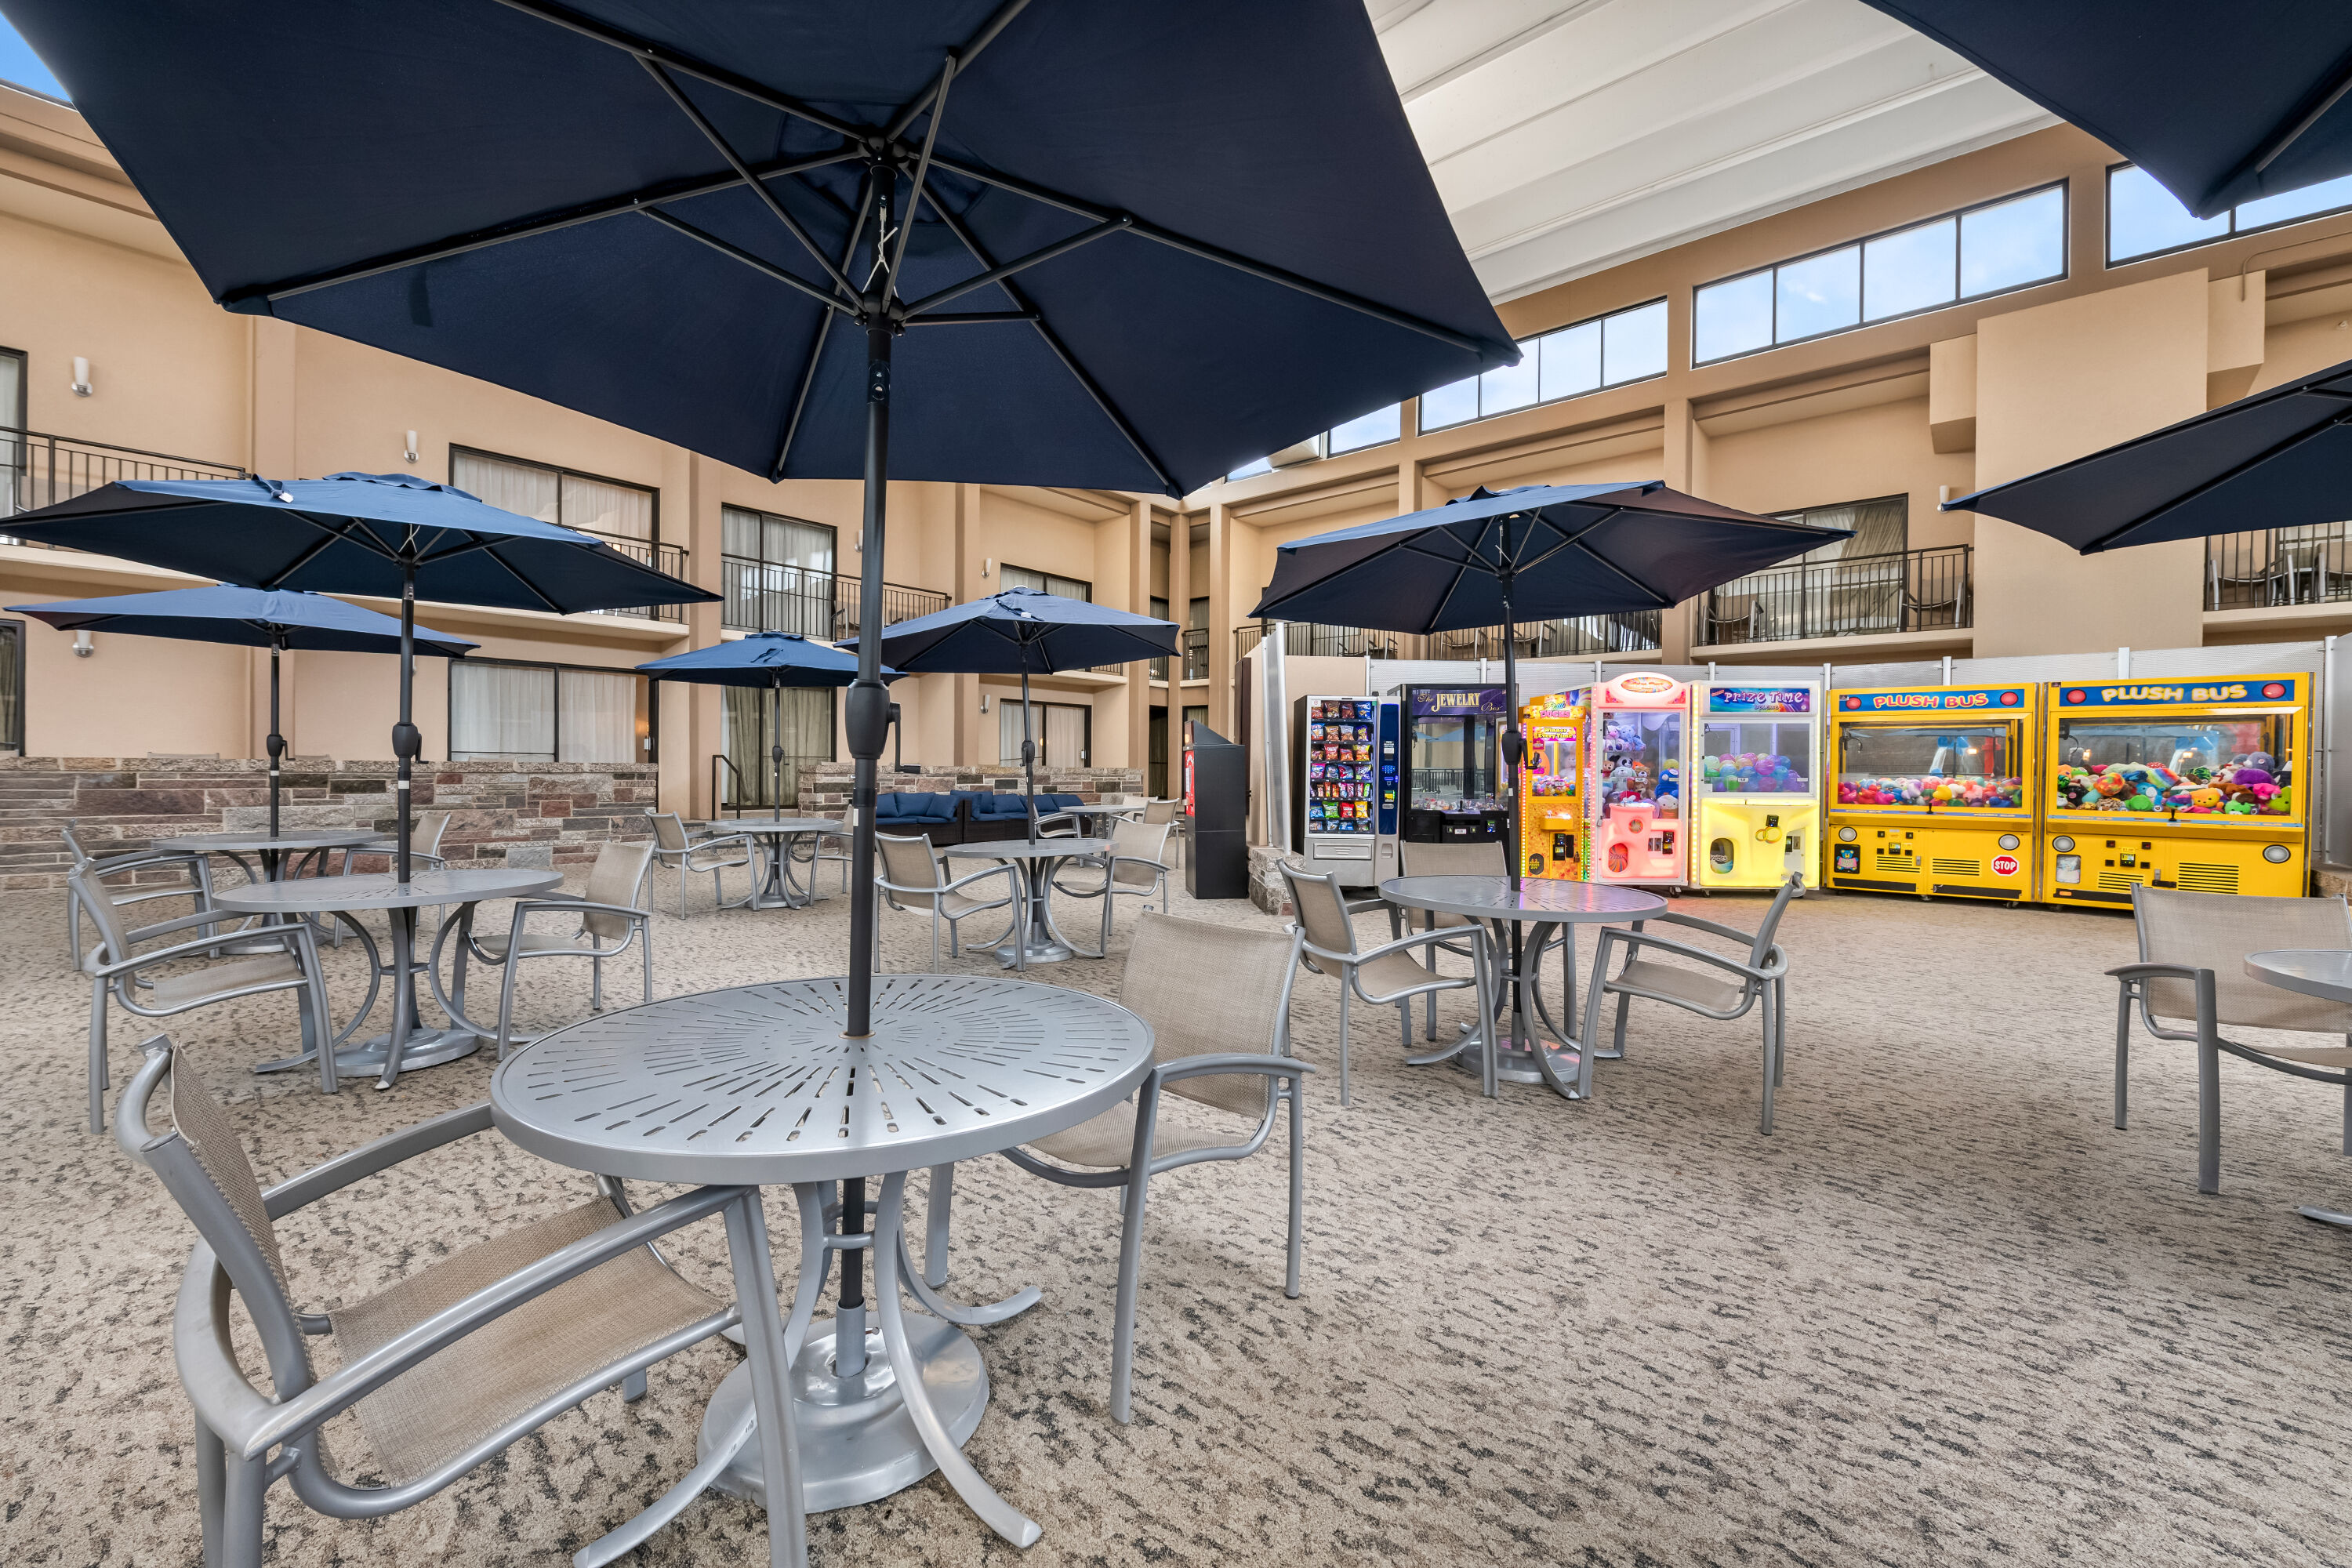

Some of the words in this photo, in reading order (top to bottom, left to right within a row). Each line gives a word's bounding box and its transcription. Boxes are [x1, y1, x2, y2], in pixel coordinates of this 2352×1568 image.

[1417, 693, 1434, 702] The
[2101, 687, 2183, 702] PLUSH
[2191, 684, 2248, 701] BUS
[1431, 693, 1480, 712] JEWELRY
[1480, 702, 1504, 712] Box
[1874, 695, 1938, 709] PLUSH
[1944, 693, 1989, 708] BUS
[1994, 860, 2016, 870] STOP
